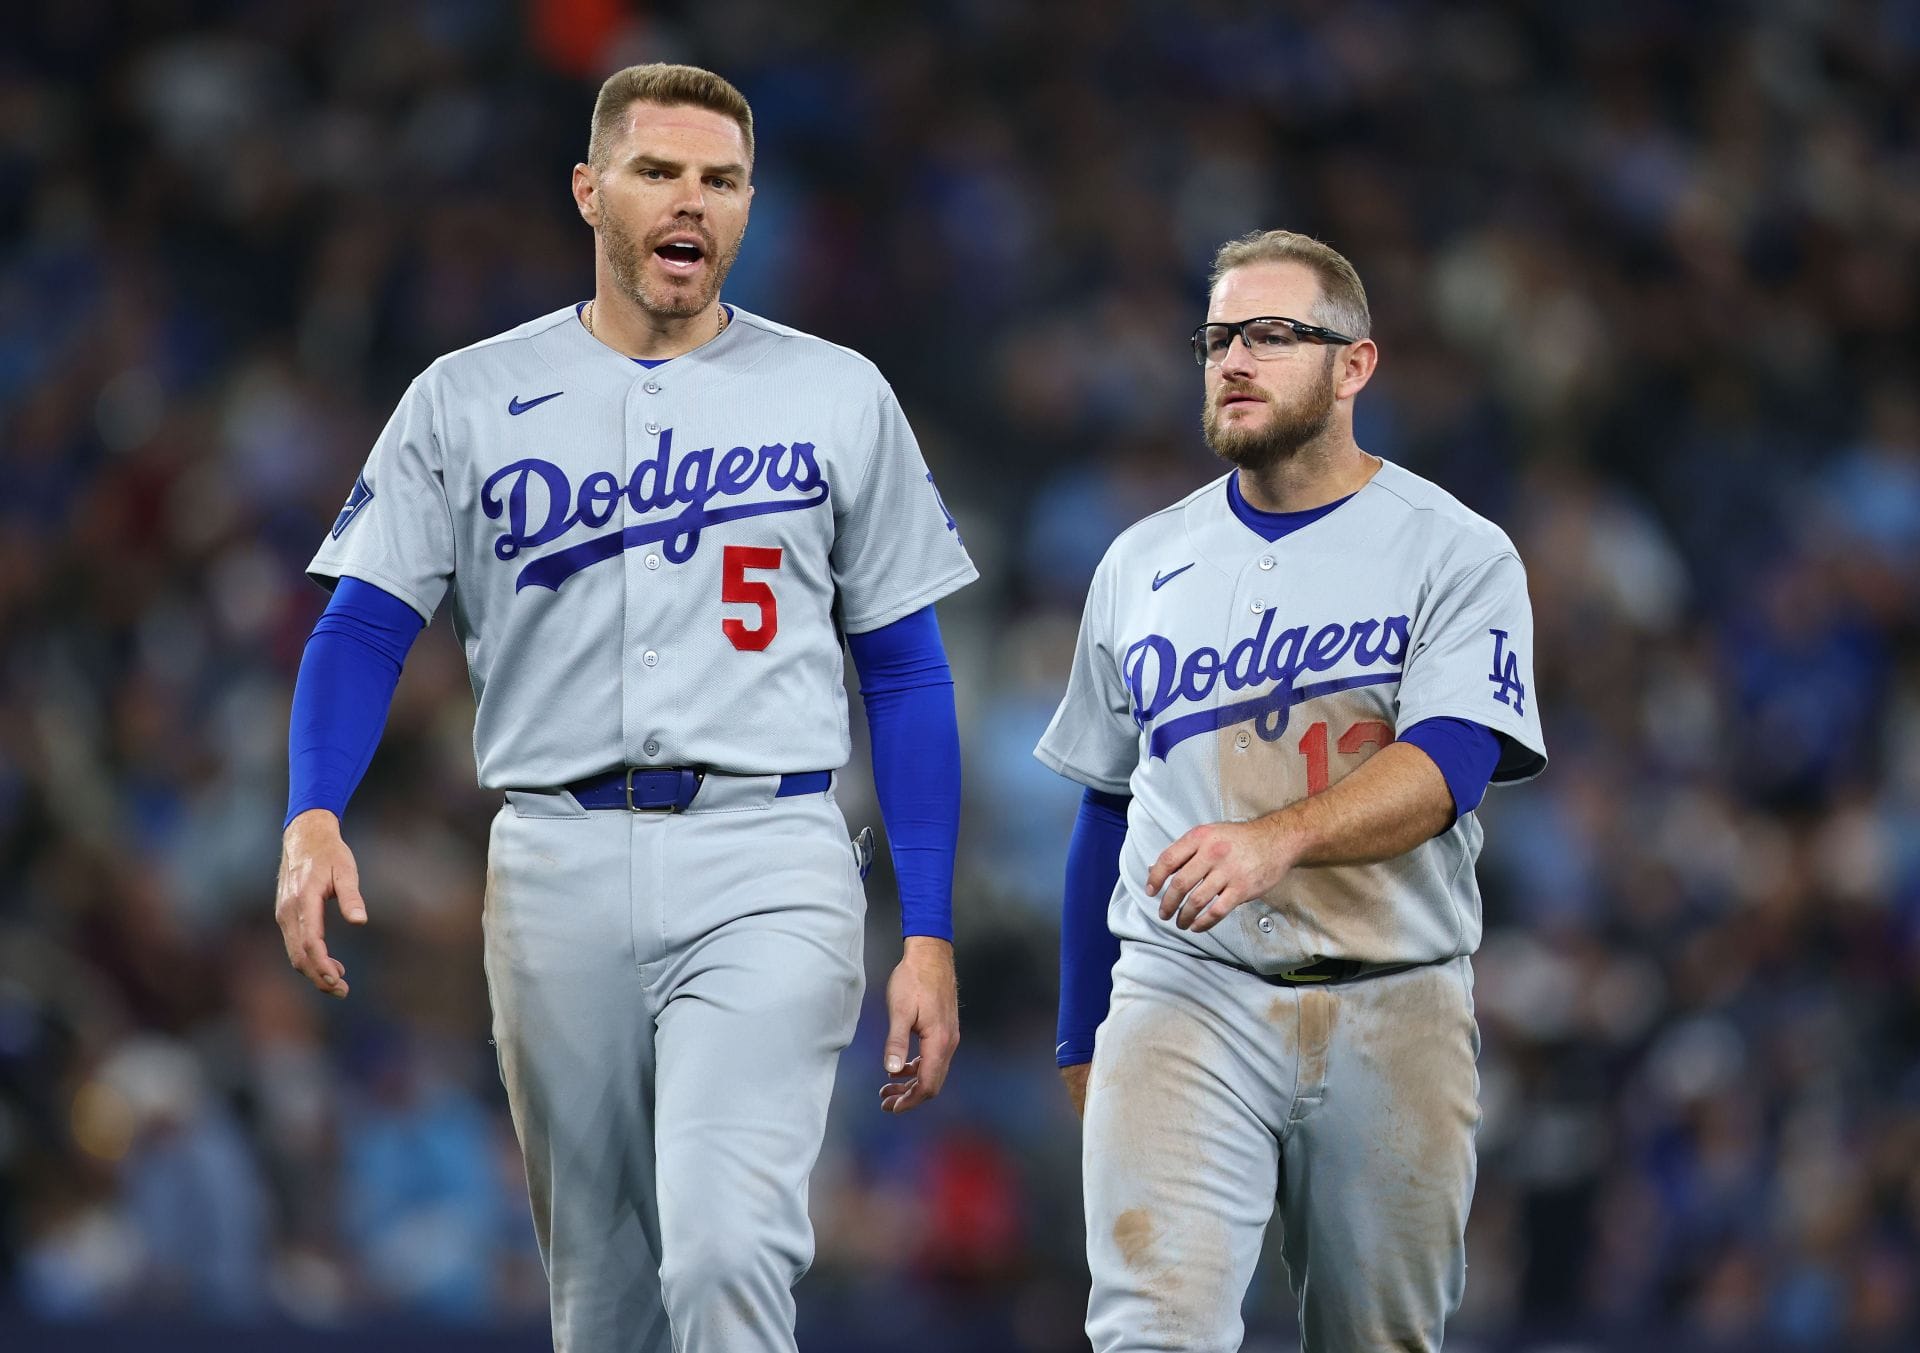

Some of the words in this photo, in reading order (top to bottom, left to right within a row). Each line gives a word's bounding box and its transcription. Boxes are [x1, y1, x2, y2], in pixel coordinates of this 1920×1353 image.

[481, 428, 829, 565] Dodgers
[722, 545, 782, 652] 5
[1123, 606, 1410, 742] Dodgers
[1488, 628, 1524, 717] LA
